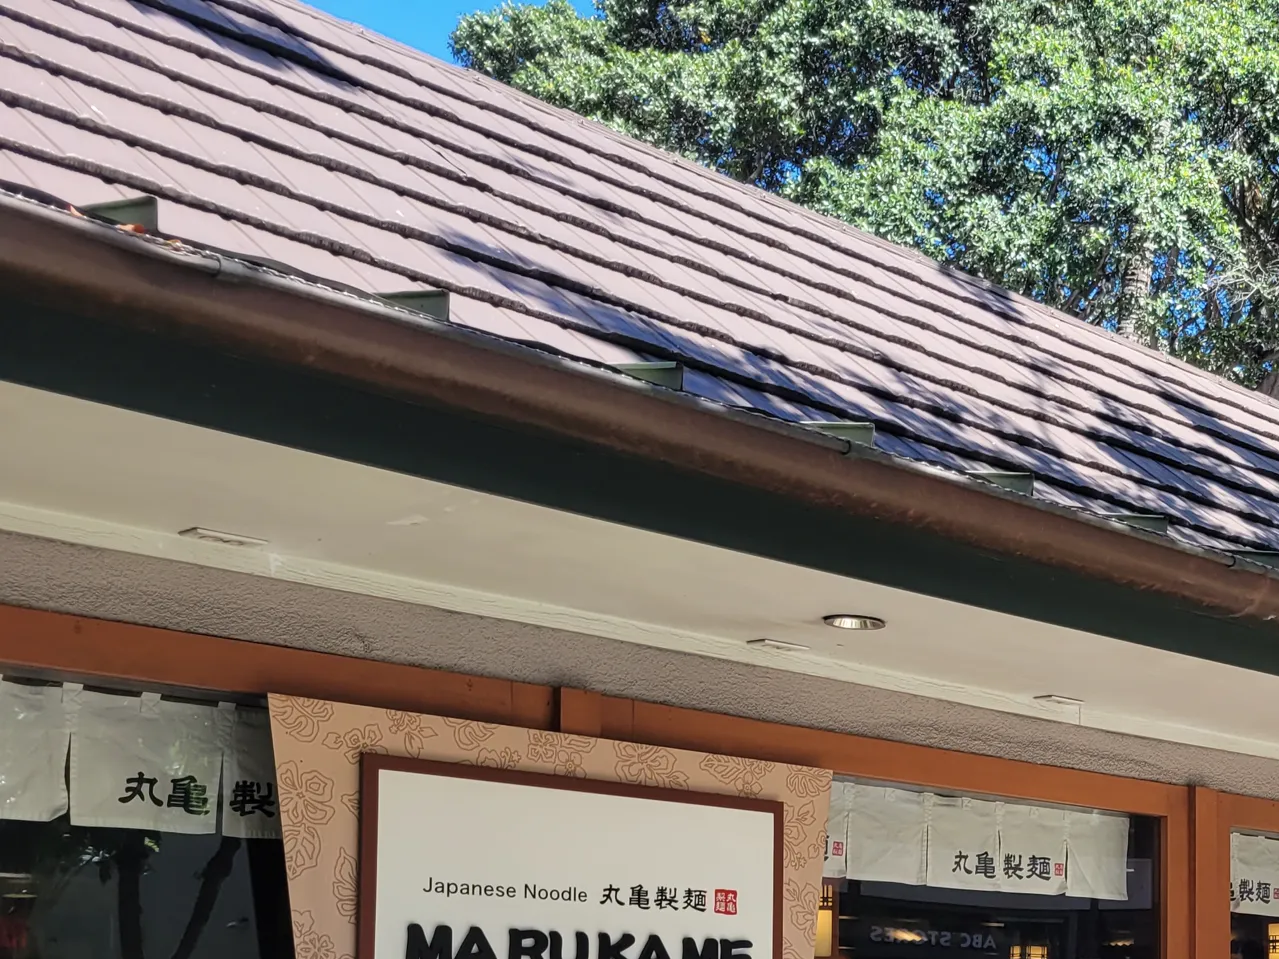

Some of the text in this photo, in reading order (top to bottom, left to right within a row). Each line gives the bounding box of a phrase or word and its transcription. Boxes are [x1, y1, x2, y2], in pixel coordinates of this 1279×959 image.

[952, 850, 1051, 881] 丸亀製麺
[422, 876, 588, 903] Japanese Noodle
[599, 883, 707, 913] 丸亀製麺
